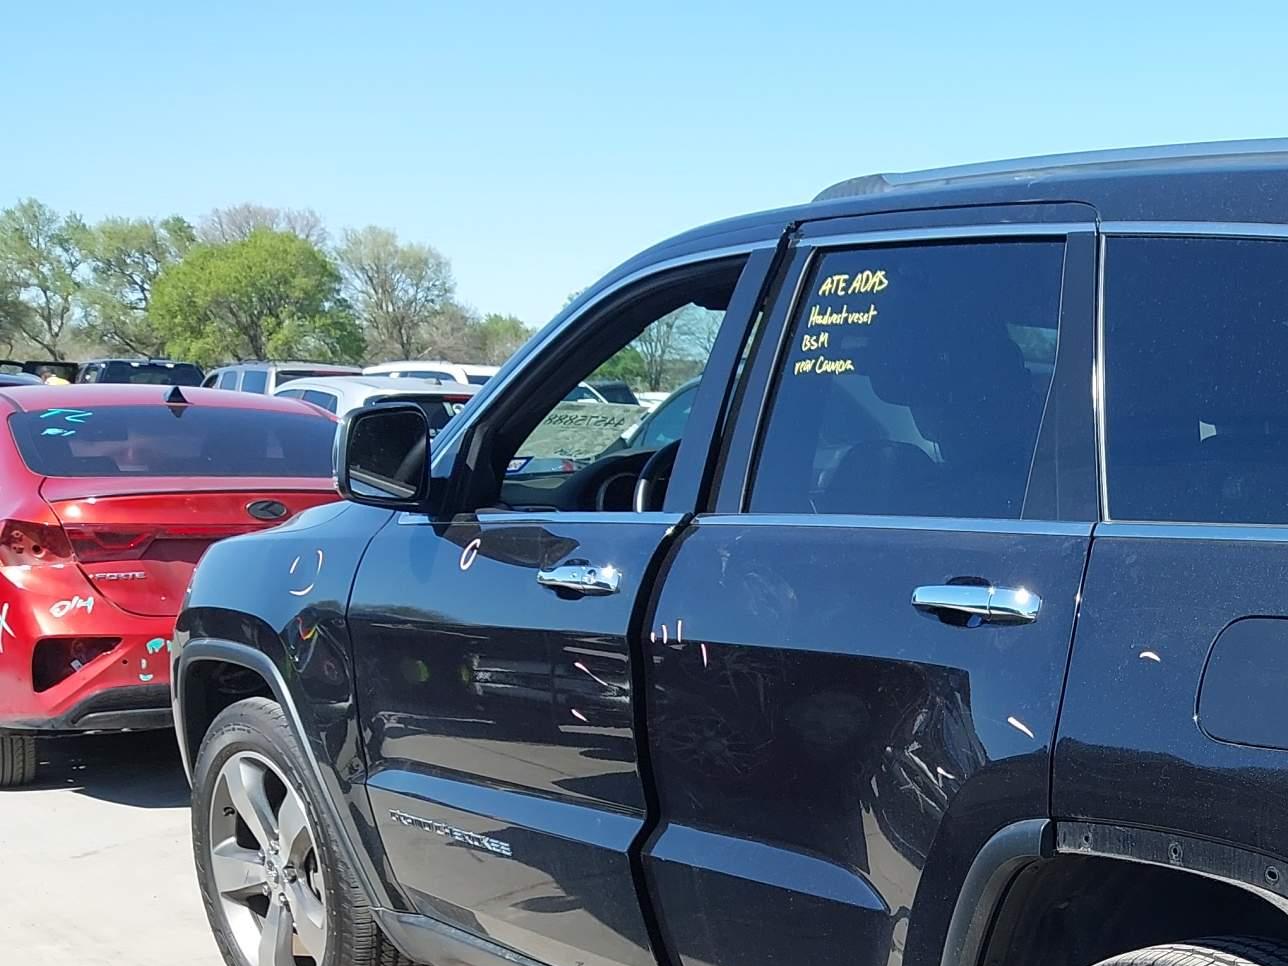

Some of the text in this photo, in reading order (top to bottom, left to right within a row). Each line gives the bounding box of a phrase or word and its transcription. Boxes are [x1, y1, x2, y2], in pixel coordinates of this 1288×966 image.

[848, 270, 889, 294] ADAS
[801, 331, 829, 352] BSM
[95, 571, 146, 581] FORTE
